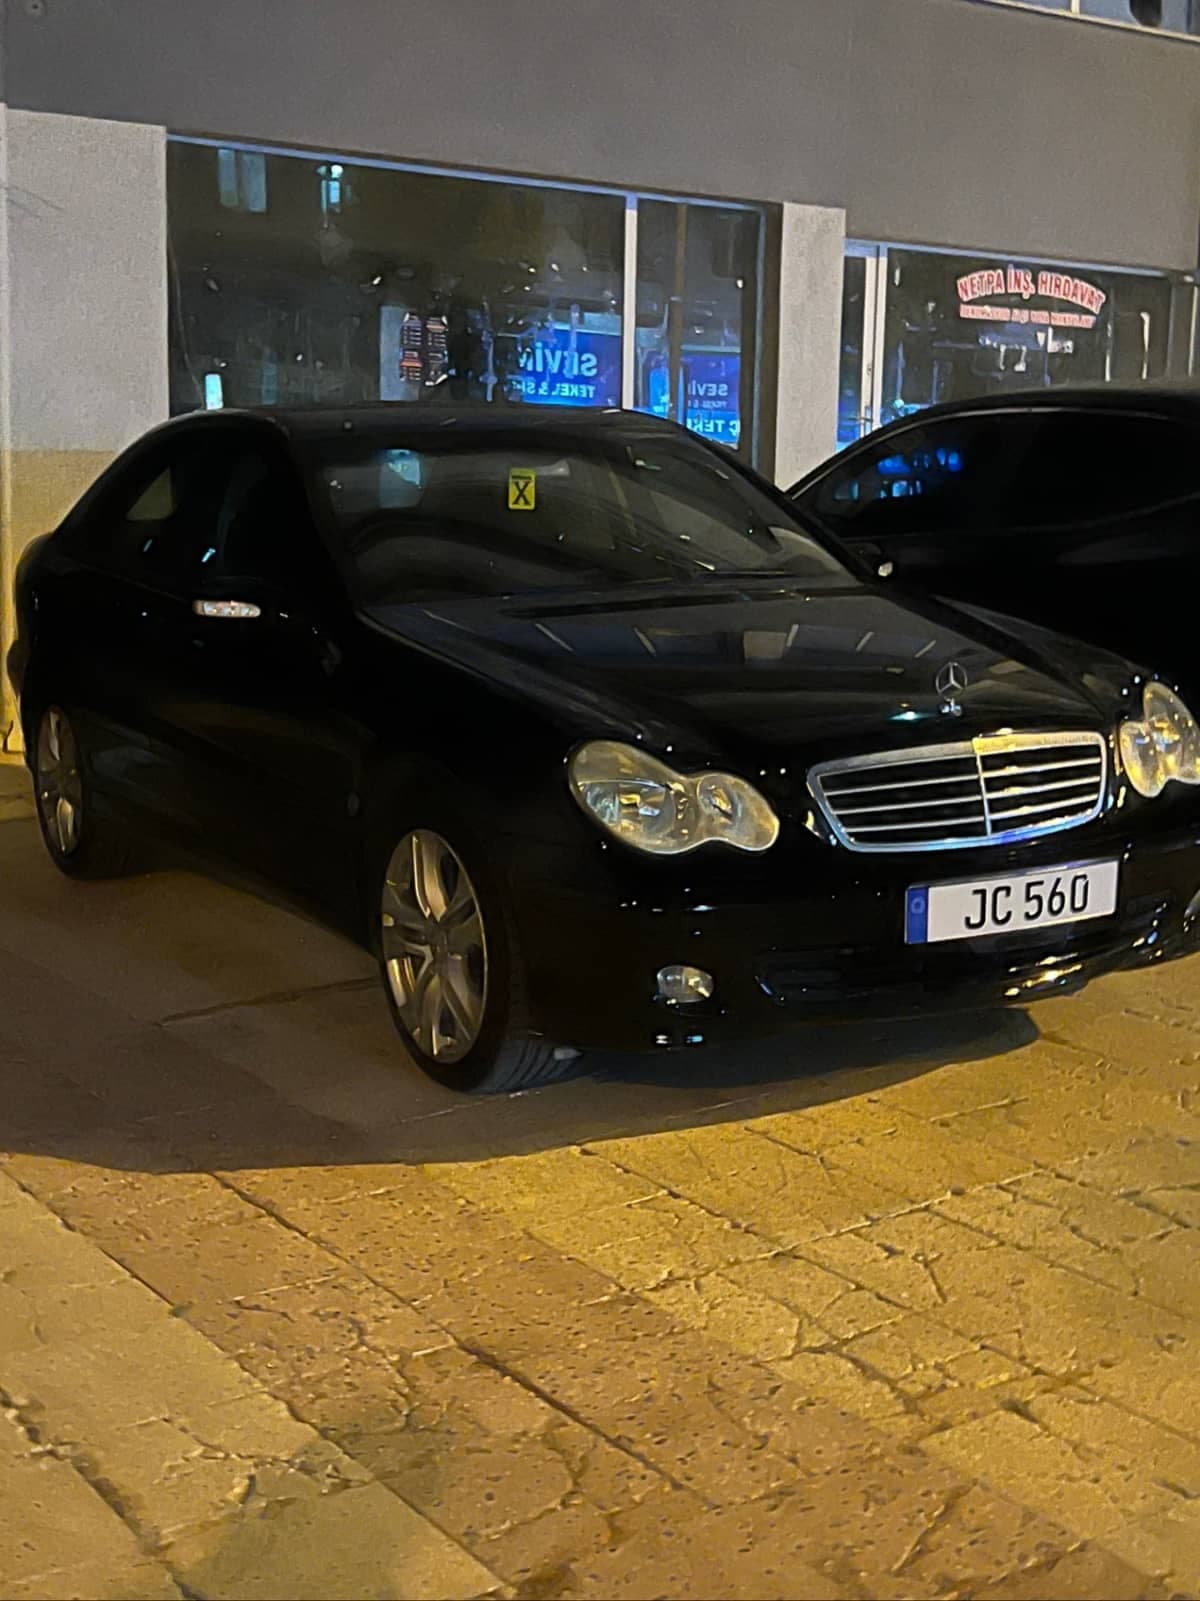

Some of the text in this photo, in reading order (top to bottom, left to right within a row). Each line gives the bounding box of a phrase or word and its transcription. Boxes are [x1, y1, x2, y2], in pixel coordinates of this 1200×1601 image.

[957, 269, 1005, 301] NETPA
[1038, 271, 1106, 314] HIRDAVAT
[512, 481, 531, 505] X
[964, 873, 1089, 929] JC 560
